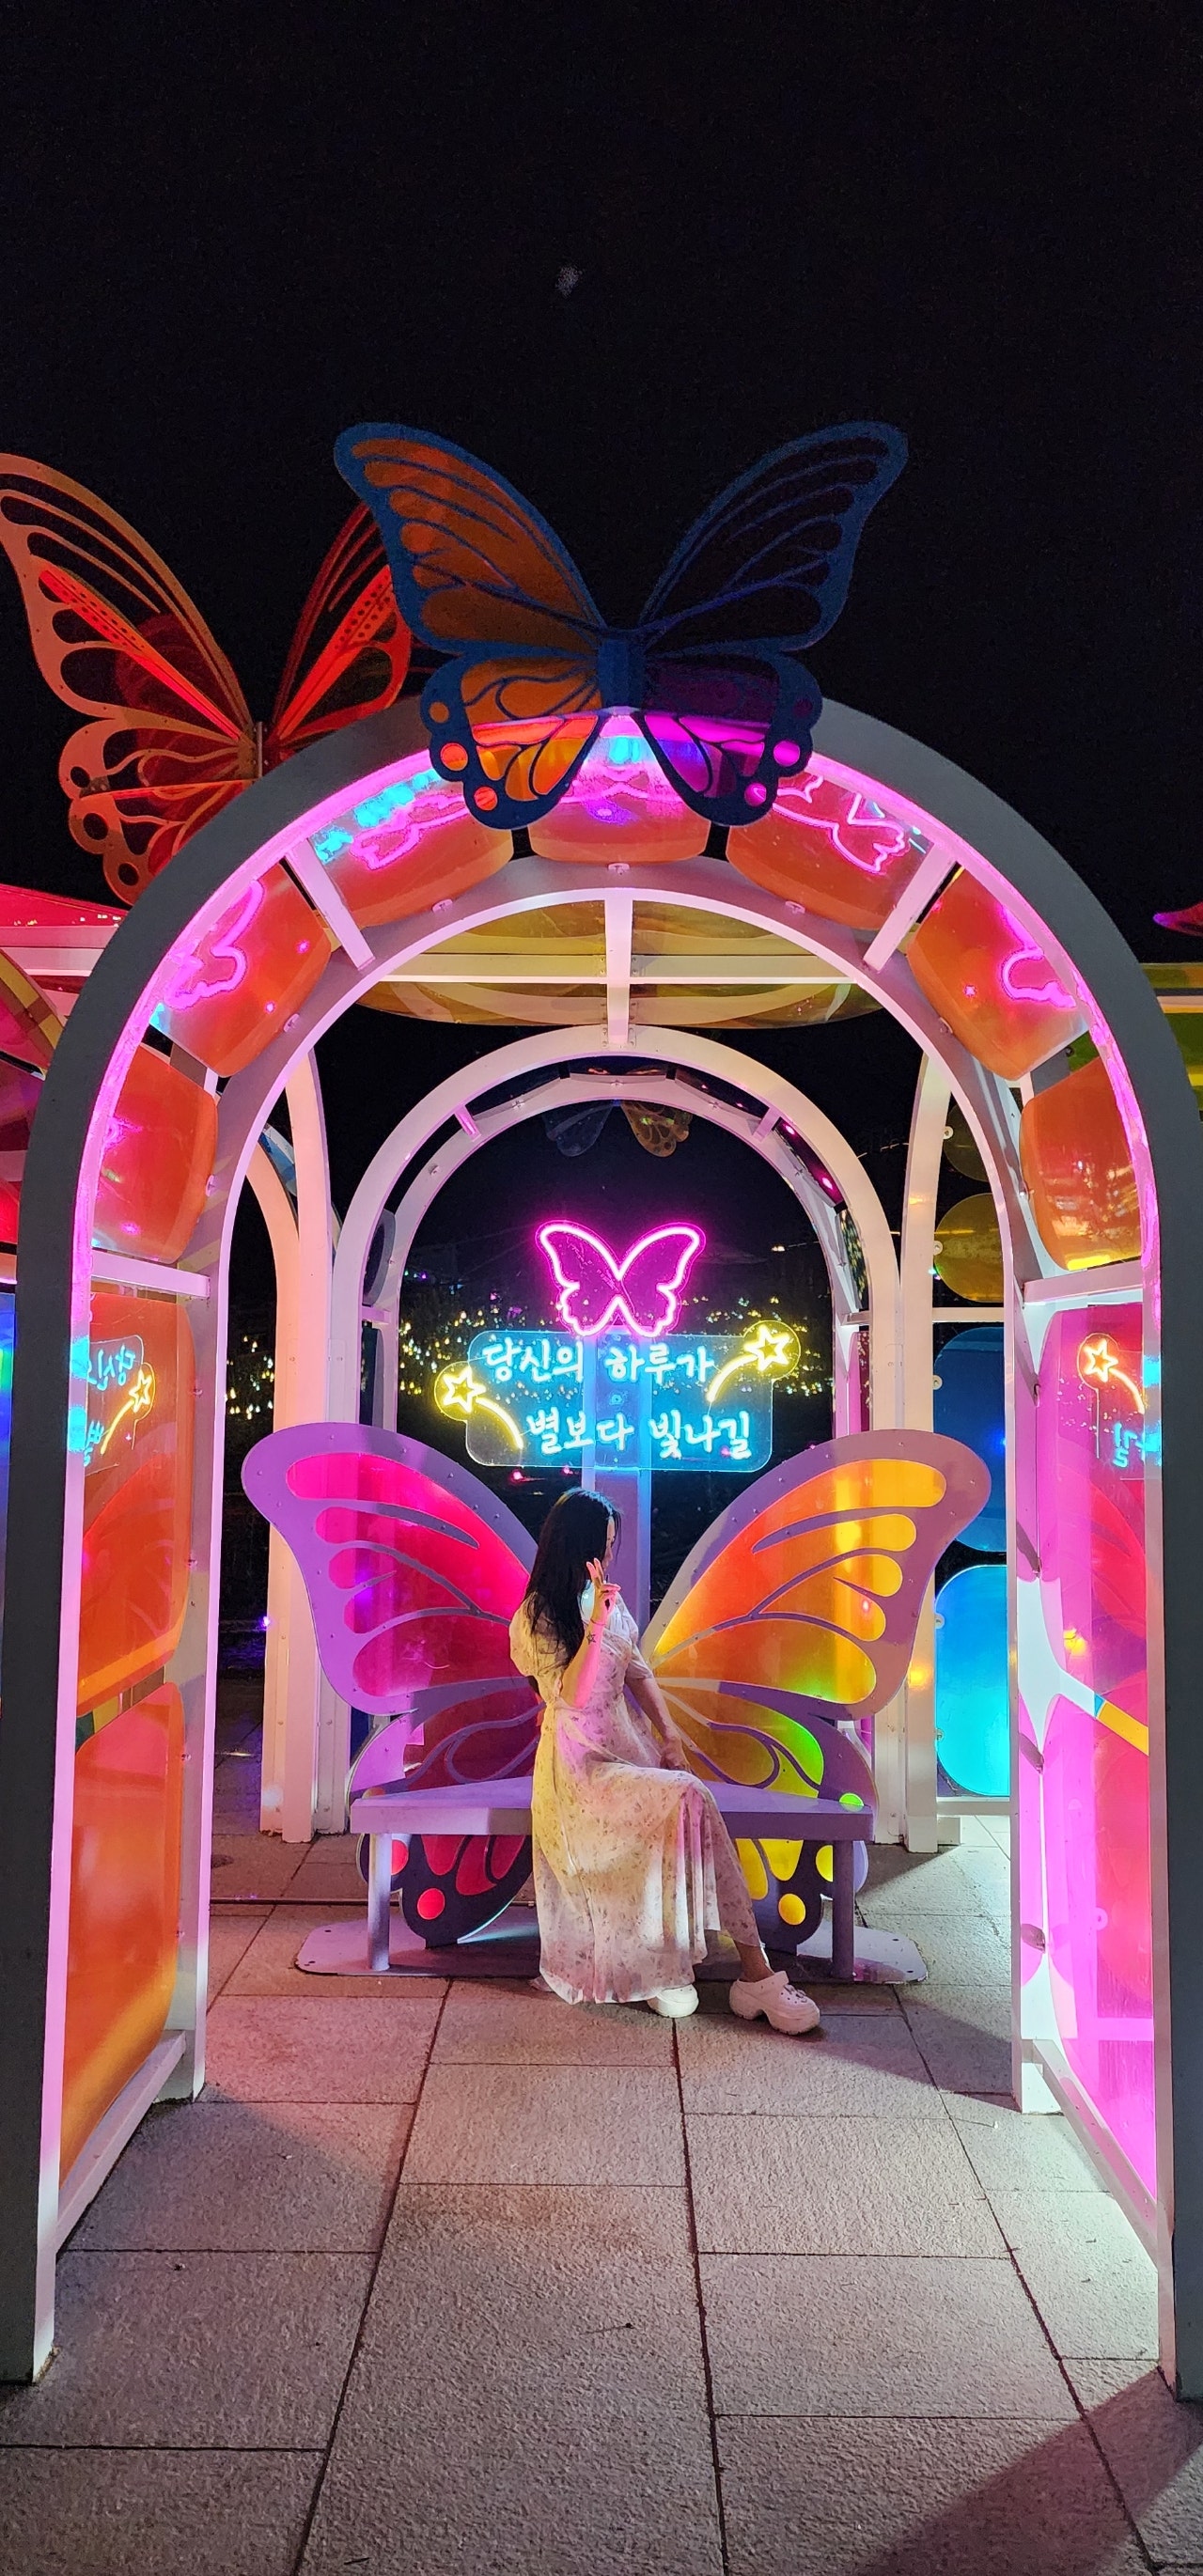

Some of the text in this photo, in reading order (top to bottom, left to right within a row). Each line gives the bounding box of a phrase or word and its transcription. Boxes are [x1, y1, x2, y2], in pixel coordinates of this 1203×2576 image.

[482, 1337, 714, 1383] 당신의 하루가
[526, 1407, 752, 1460] 별보다 빛나길
